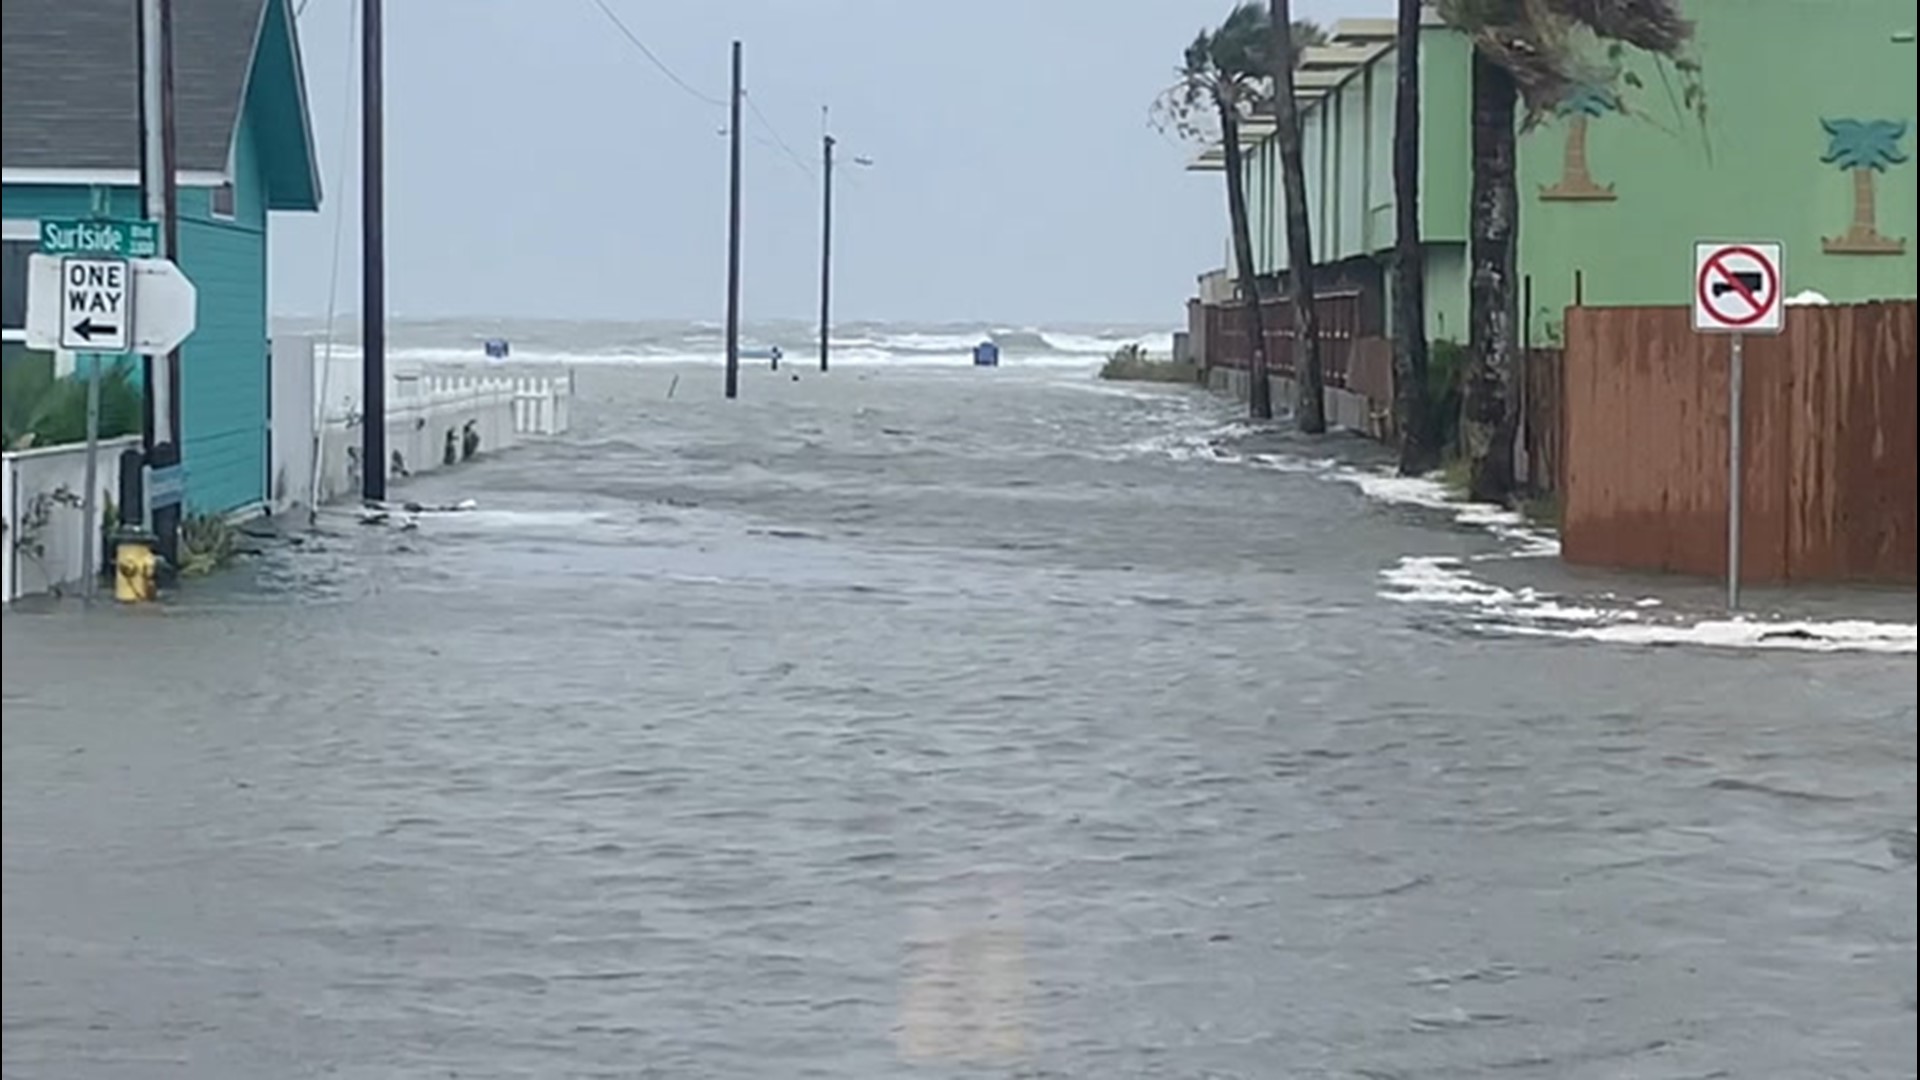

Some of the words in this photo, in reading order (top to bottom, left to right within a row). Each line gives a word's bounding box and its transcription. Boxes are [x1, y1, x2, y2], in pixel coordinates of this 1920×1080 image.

[44, 223, 123, 250] Surfside
[70, 265, 121, 288] ONE
[68, 291, 121, 313] WAY
